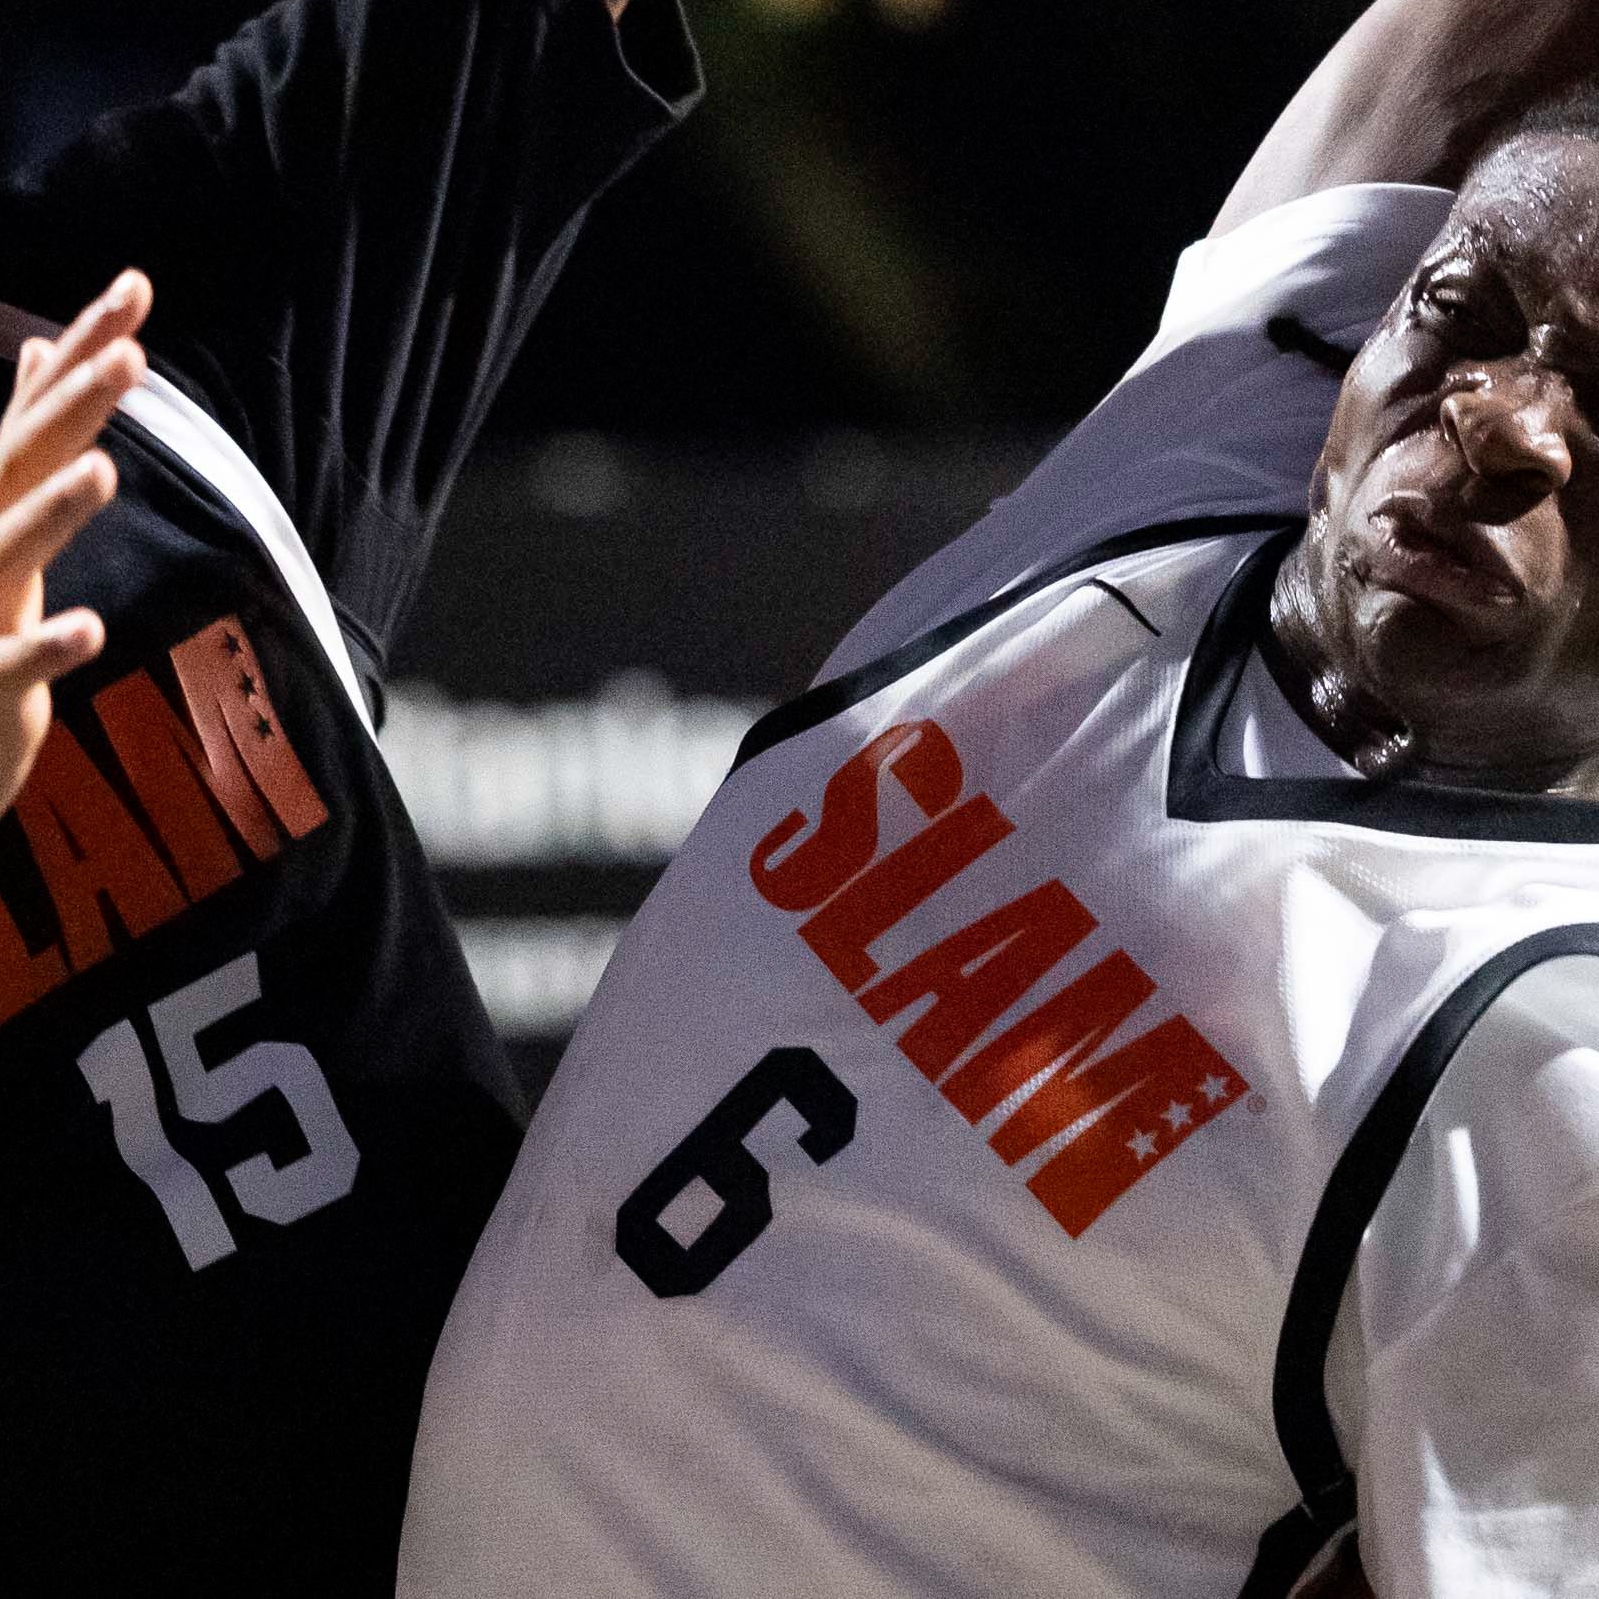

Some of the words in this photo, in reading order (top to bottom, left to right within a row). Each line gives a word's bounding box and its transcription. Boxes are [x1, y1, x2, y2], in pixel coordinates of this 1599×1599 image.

[76, 950, 361, 1272] 15
[748, 717, 1250, 1240] SLAM
[614, 1046, 859, 1298] 6
